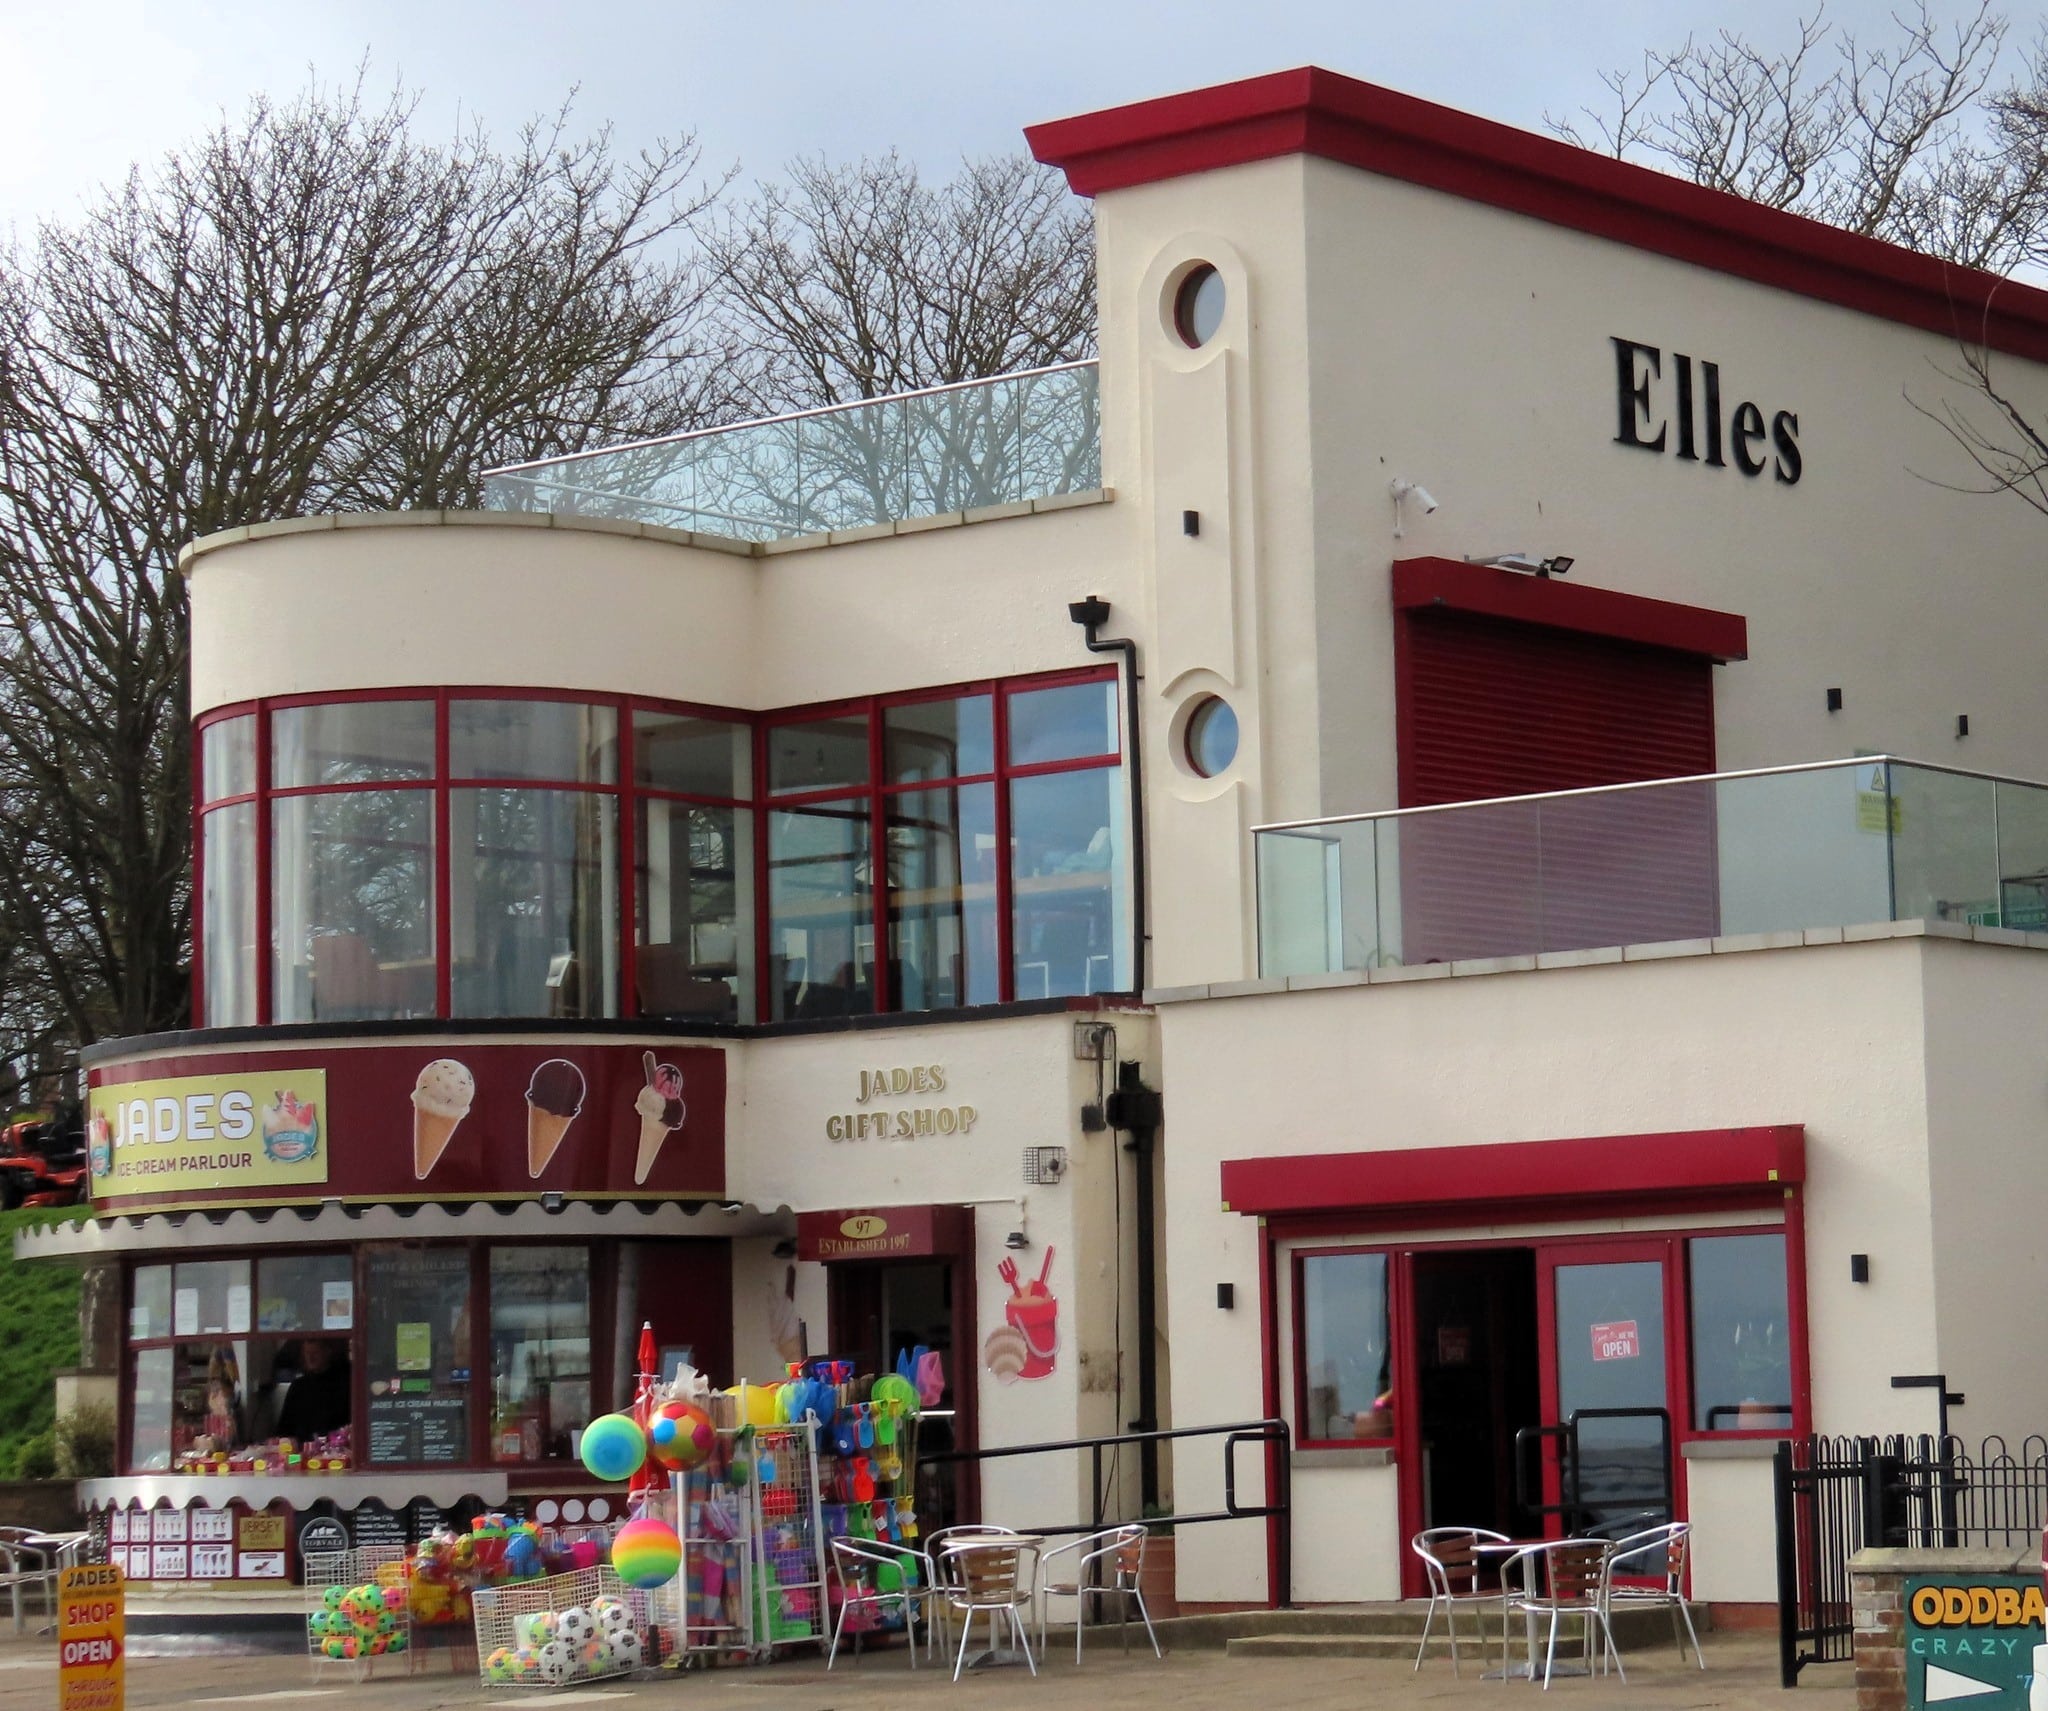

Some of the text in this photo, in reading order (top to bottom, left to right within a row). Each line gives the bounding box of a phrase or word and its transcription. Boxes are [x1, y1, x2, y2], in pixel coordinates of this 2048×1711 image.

[1610, 336, 1802, 485] Elles
[856, 1064, 945, 1103] JADES
[115, 1090, 254, 1148] JADES
[826, 1105, 977, 1142] GIFT SHOP
[117, 1153, 252, 1177] ICE-CREAM PARLOUR
[856, 1219, 870, 1234] 97
[818, 1238, 887, 1254] ESTABLISHED
[1602, 1340, 1631, 1357] OPEN
[67, 1569, 118, 1588] JADES
[68, 1602, 116, 1627] SHOP
[64, 1640, 113, 1663] OPEN
[1911, 1638, 2018, 1655] CRAZY
